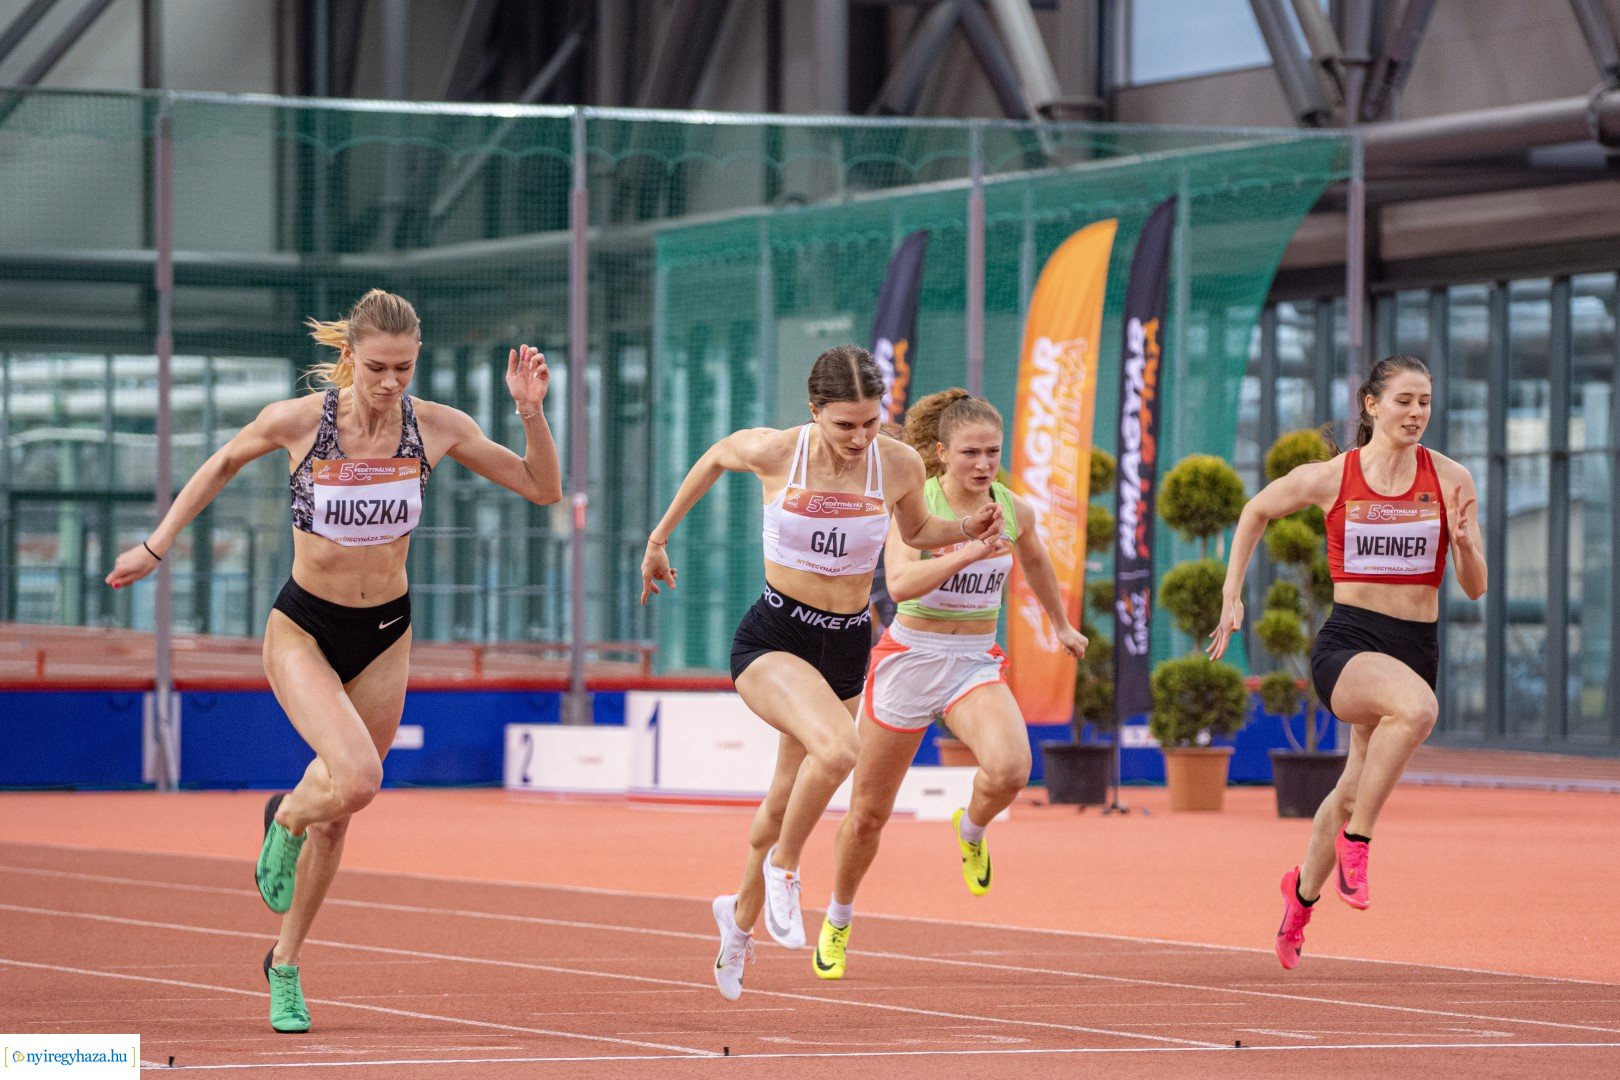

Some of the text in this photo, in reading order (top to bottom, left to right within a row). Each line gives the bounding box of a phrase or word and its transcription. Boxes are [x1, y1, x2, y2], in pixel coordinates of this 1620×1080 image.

[324, 499, 408, 526] HUSZKA
[810, 527, 849, 558] GÁL
[1356, 535, 1427, 558] WEINER
[790, 605, 871, 630] NIKE PR
[646, 699, 662, 786] 1
[520, 731, 535, 785] 2
